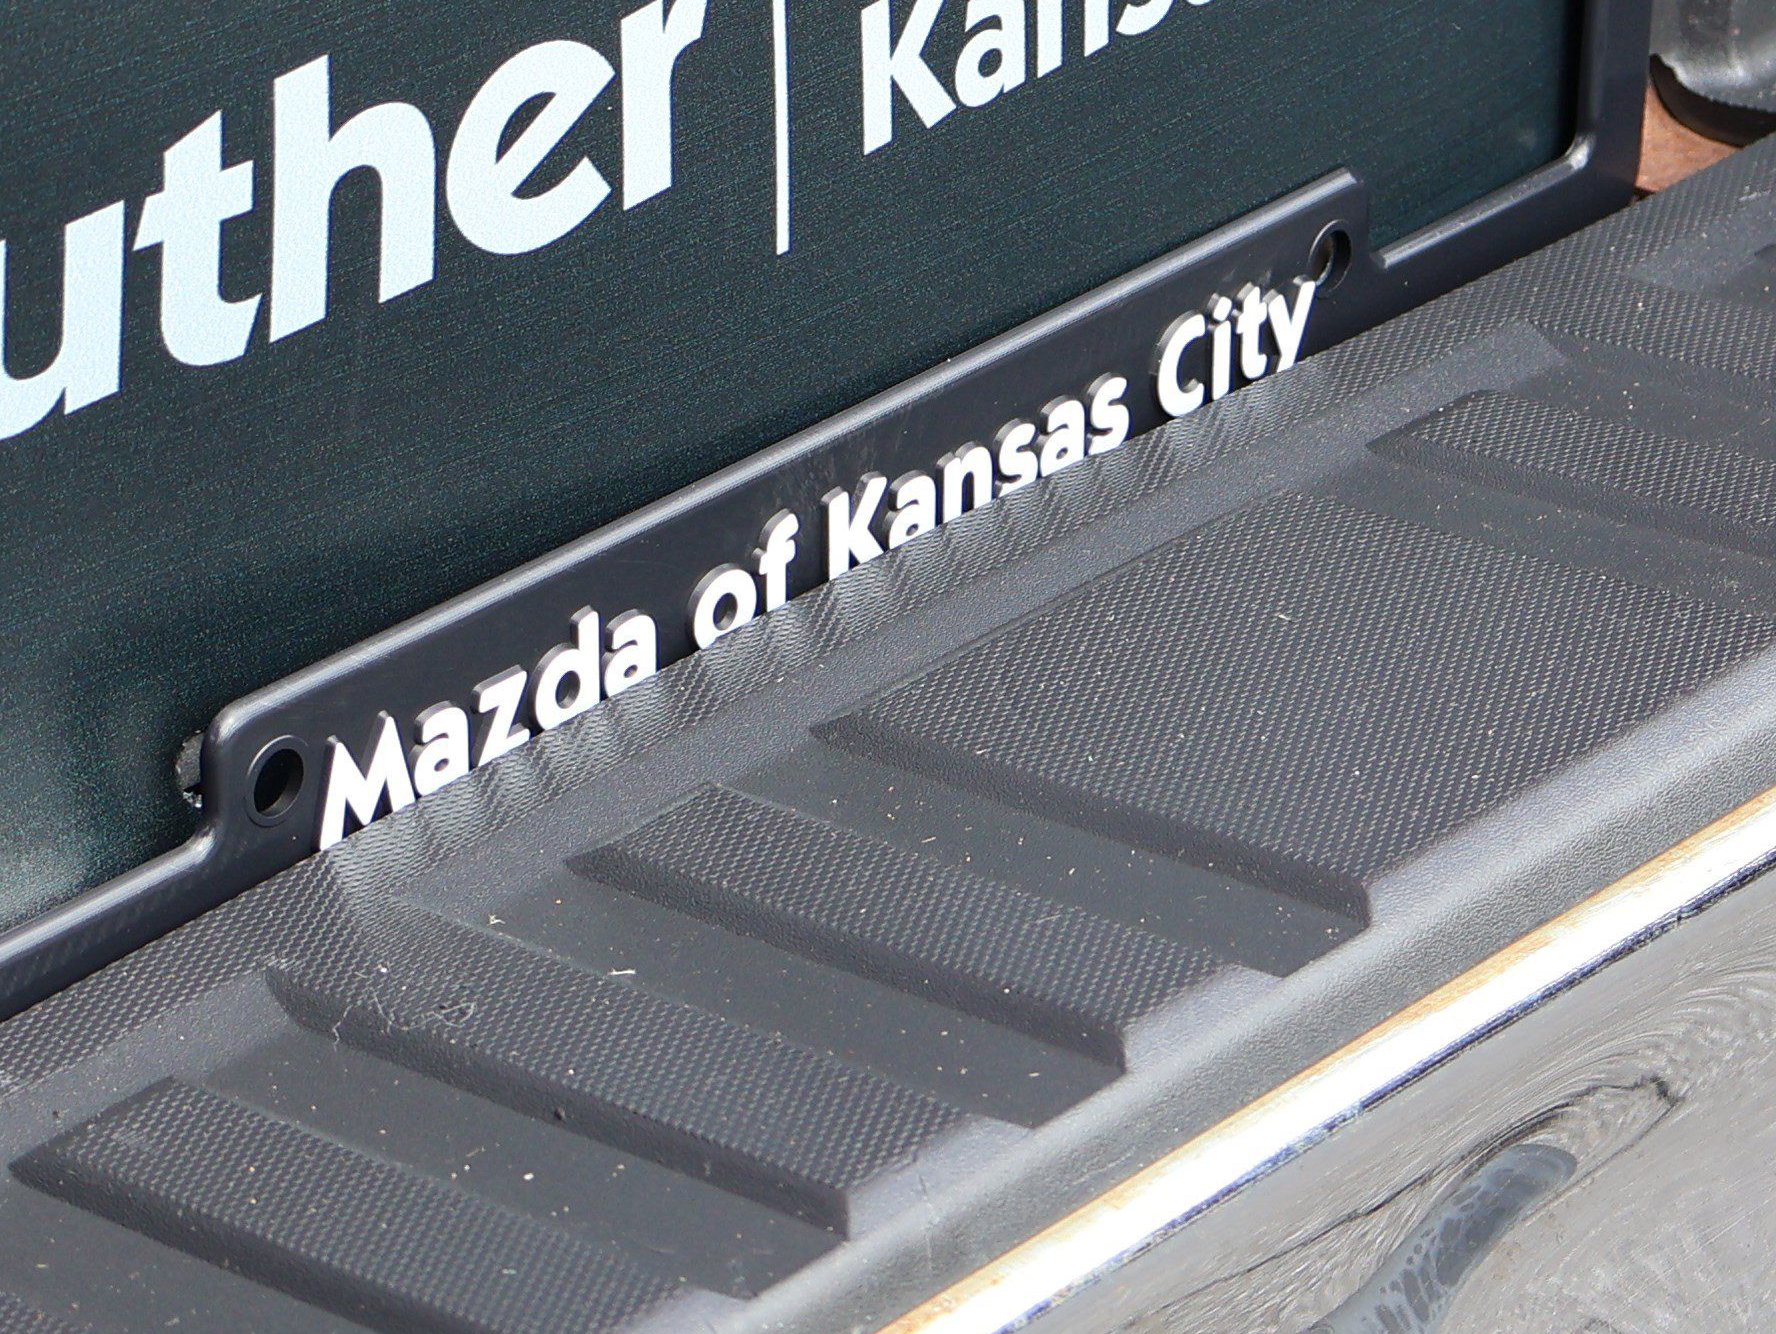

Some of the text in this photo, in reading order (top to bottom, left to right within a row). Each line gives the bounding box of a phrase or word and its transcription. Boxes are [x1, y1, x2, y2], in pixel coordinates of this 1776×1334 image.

[319, 275, 1317, 851] Mazda of Kansas City
